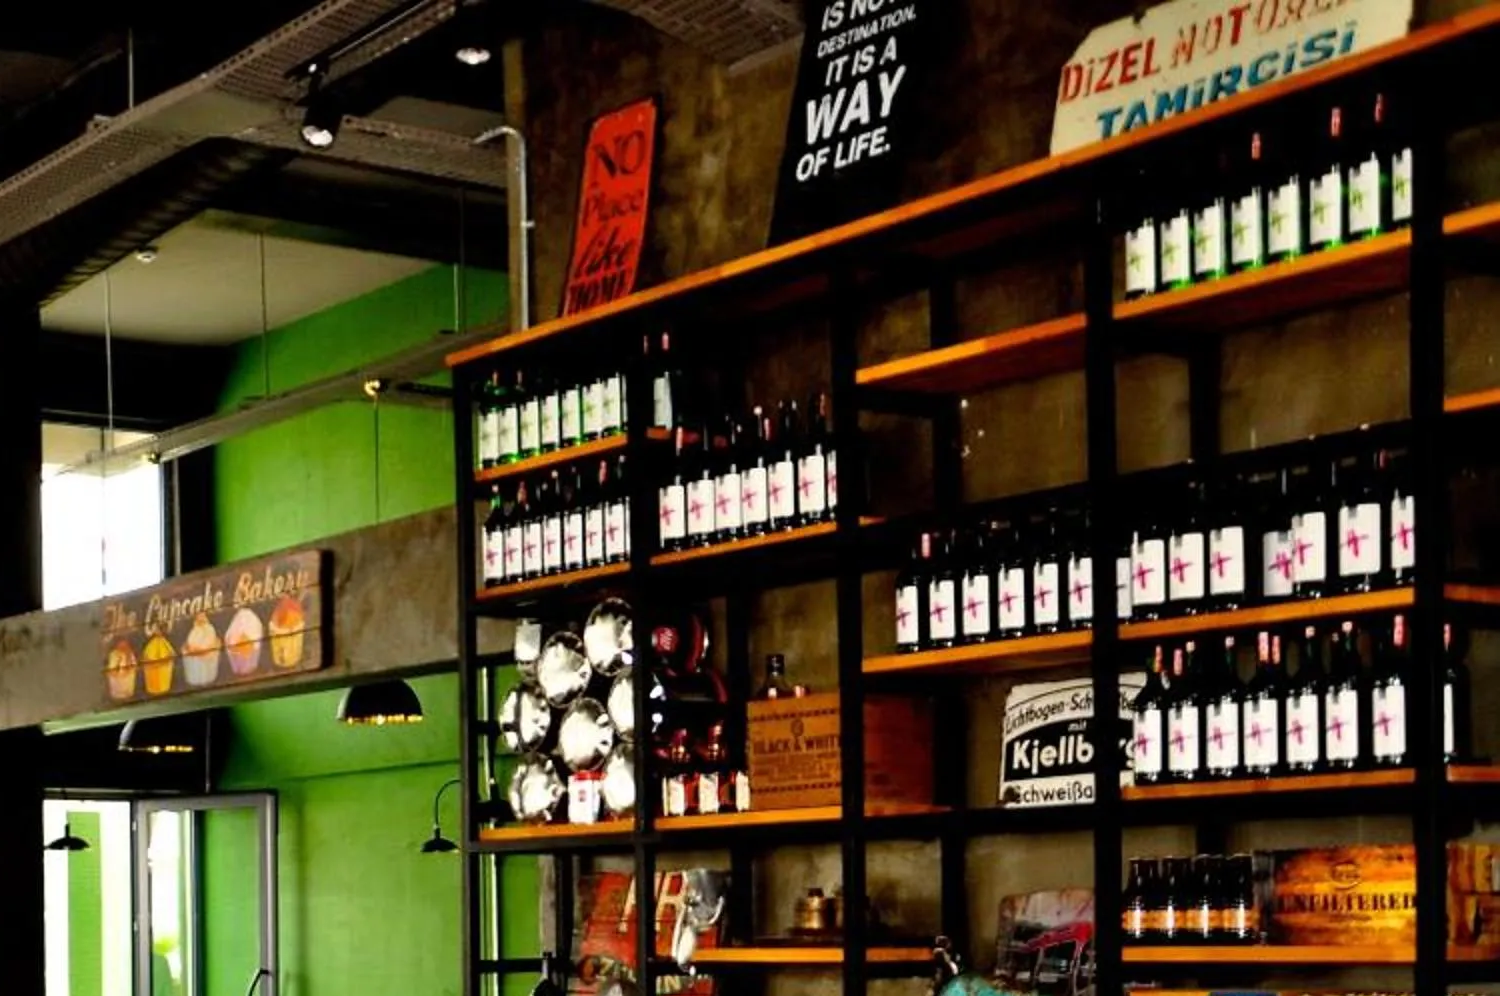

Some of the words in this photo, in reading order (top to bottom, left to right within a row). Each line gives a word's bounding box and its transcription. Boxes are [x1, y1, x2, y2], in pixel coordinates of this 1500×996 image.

[817, 4, 916, 58] DESTINATION.
[821, 0, 845, 32] IS
[825, 55, 849, 86] IT
[851, 44, 876, 76] IS
[879, 35, 897, 66] A
[805, 64, 907, 145] WAY
[796, 146, 831, 182] OF
[833, 125, 891, 169] LIFE.
[102, 602, 137, 642] The
[144, 582, 223, 636] Cupcake
[233, 566, 311, 608] Bakery
